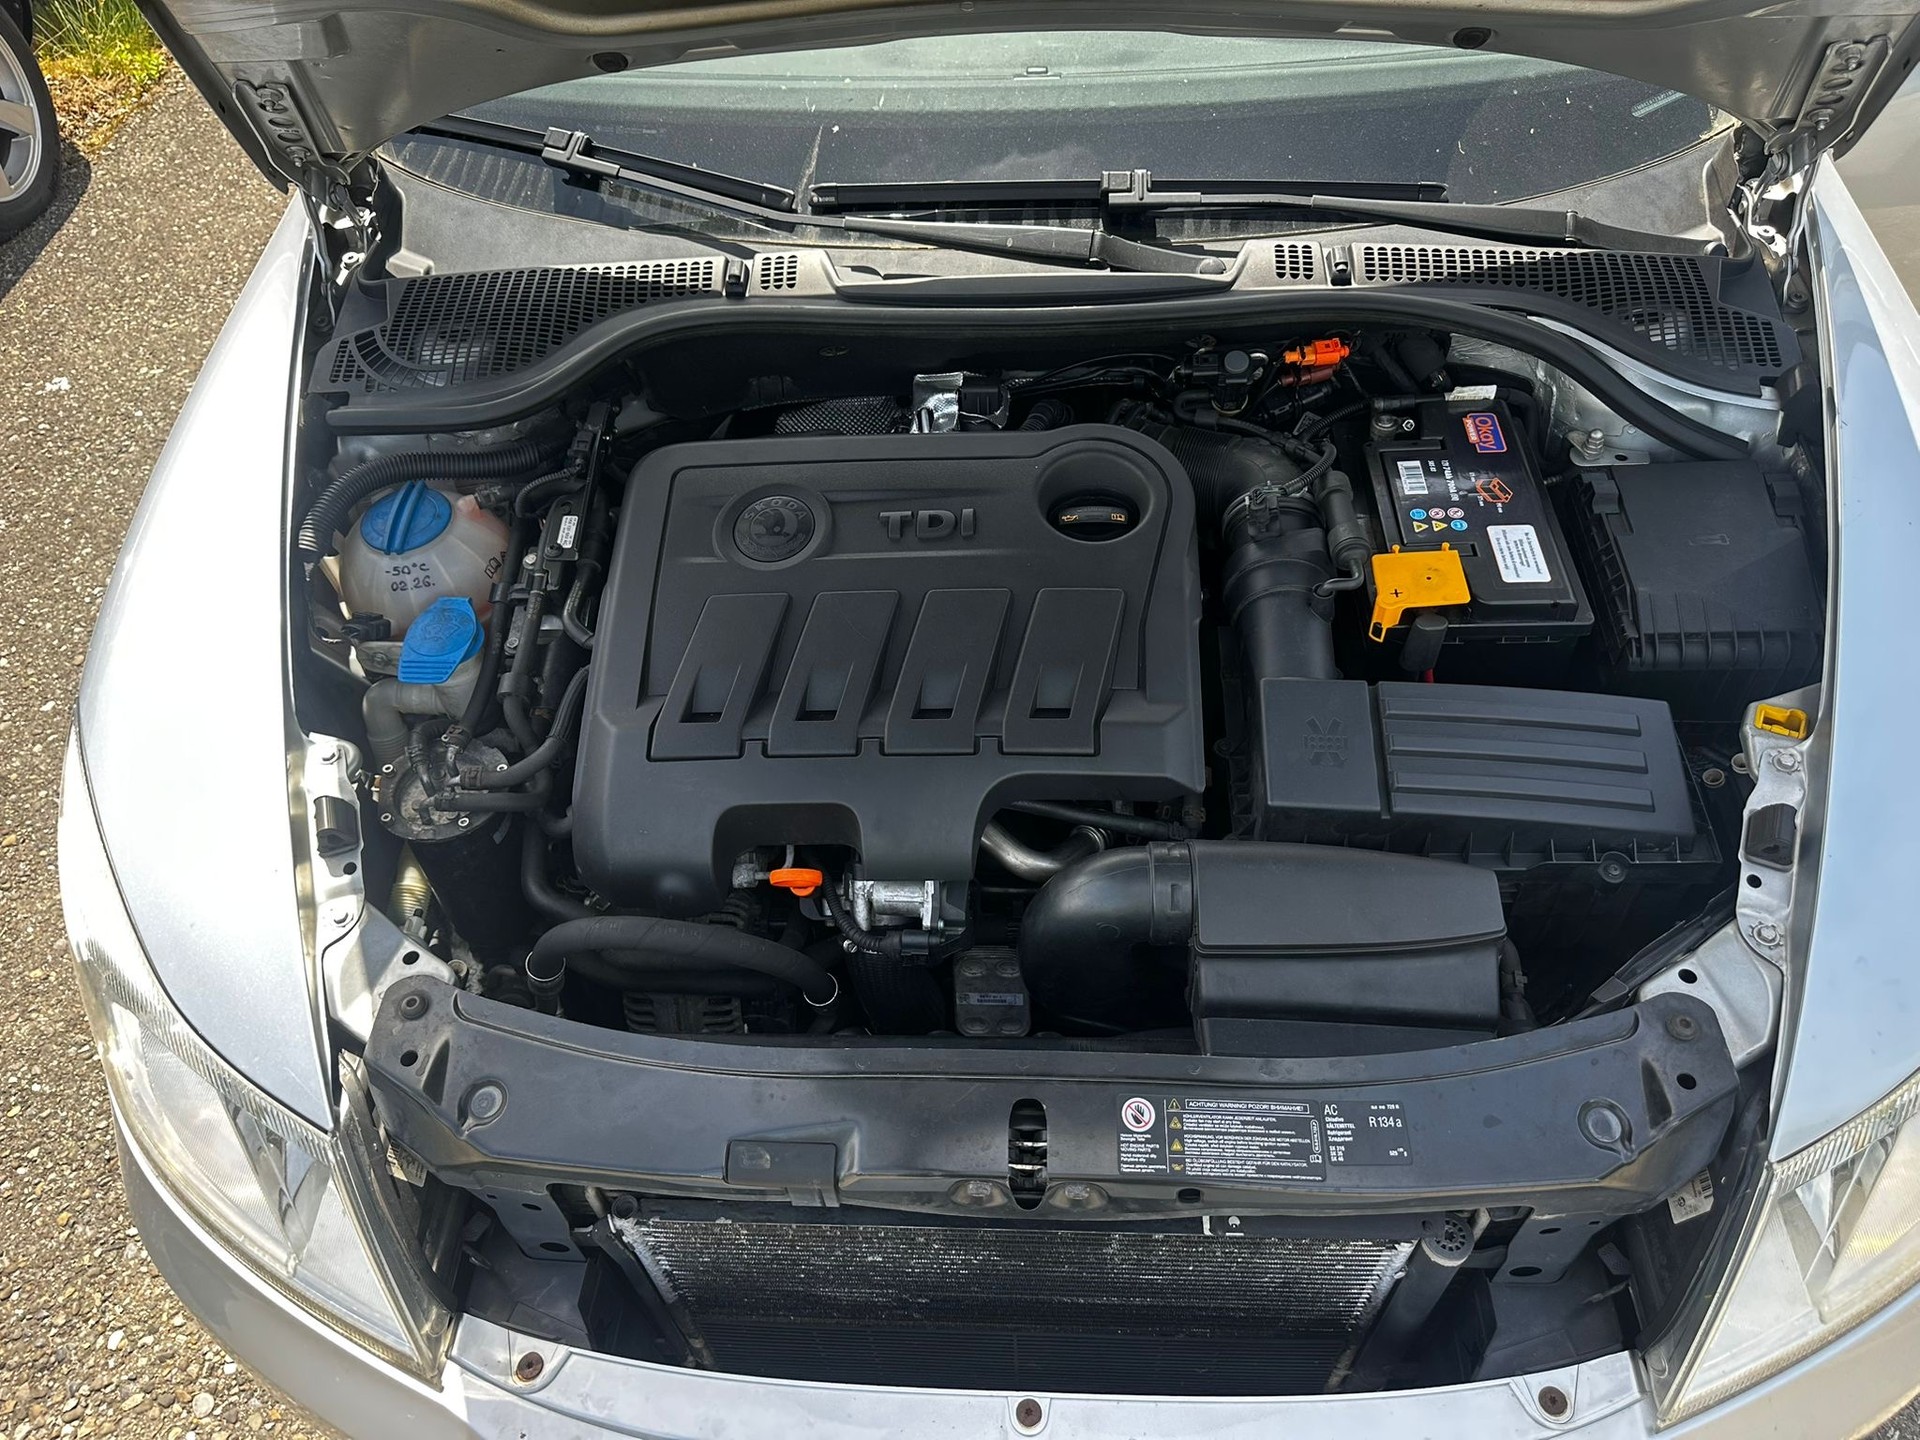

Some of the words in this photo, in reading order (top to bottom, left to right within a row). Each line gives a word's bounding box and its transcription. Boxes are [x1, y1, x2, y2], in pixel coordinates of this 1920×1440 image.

[1465, 418, 1478, 441] POWER
[1475, 417, 1497, 449] Okay
[880, 508, 975, 538] TDI
[385, 562, 430, 576] -50°C
[1324, 1104, 1338, 1116] AC
[1368, 1116, 1377, 1127] R
[1377, 1116, 1394, 1127] 134
[1396, 1118, 1402, 1127] a
